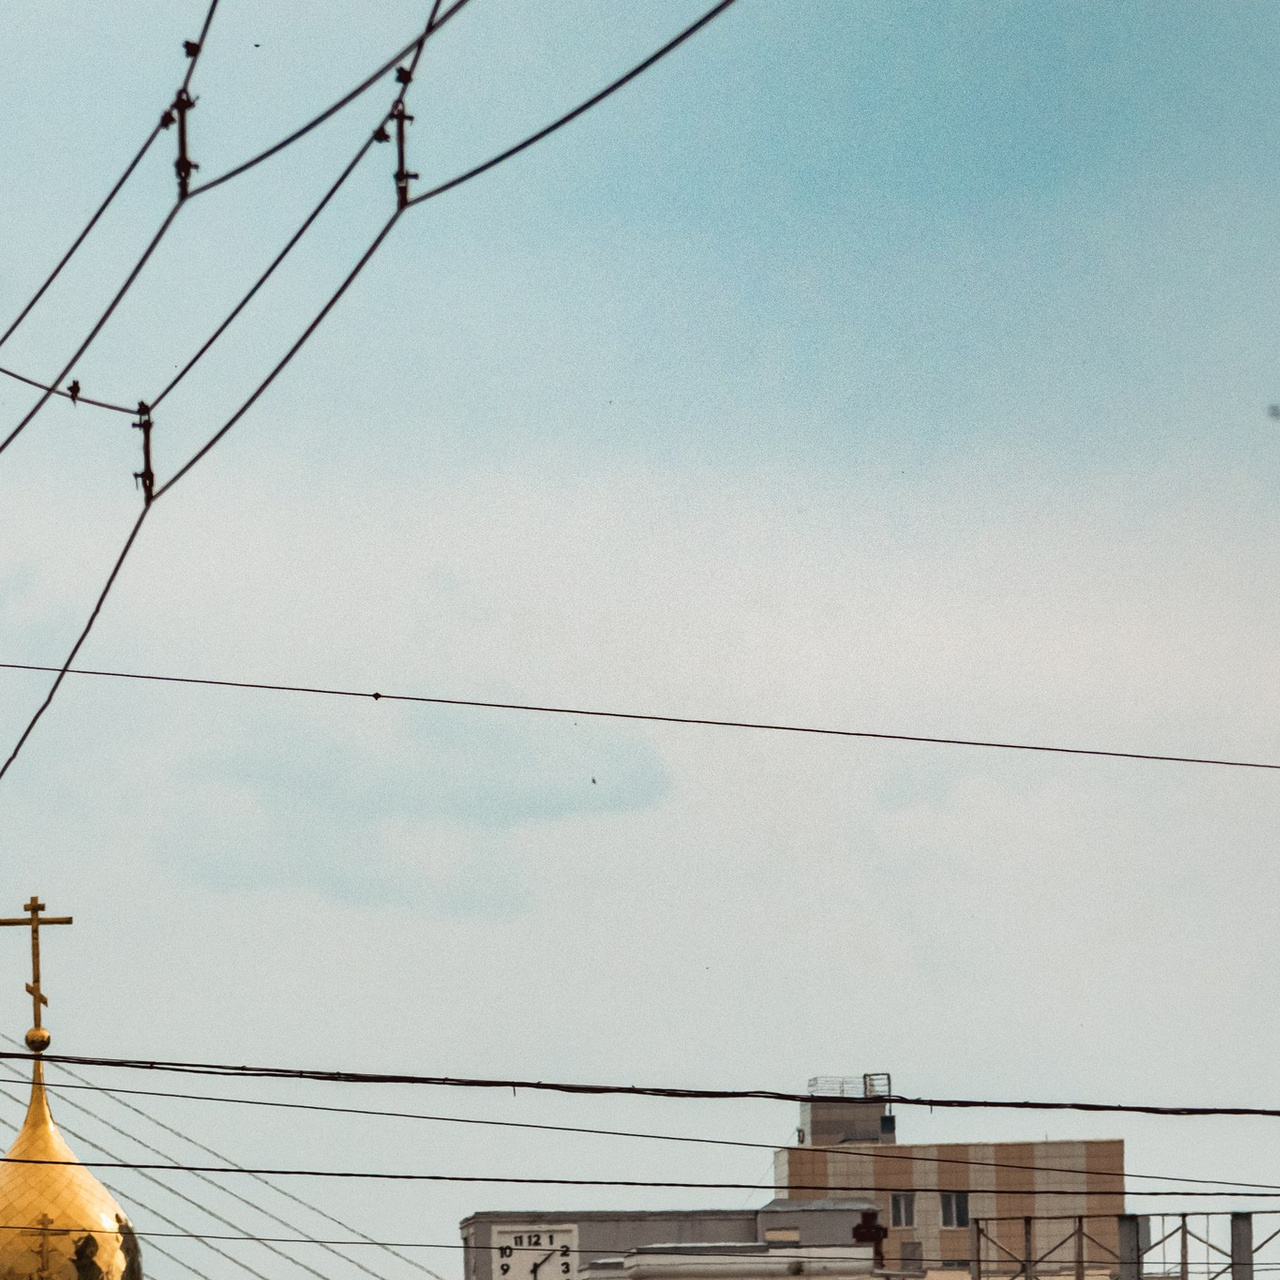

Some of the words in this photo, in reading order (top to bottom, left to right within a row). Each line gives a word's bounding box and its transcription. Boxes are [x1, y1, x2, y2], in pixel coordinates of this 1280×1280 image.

[514, 1235, 523, 1246] 11
[527, 1234, 541, 1246] 12
[548, 1234, 554, 1246] 1
[499, 1245, 513, 1259] 10
[560, 1245, 570, 1257] 2
[500, 1263, 510, 1276] 9
[561, 1262, 570, 1274] 3
